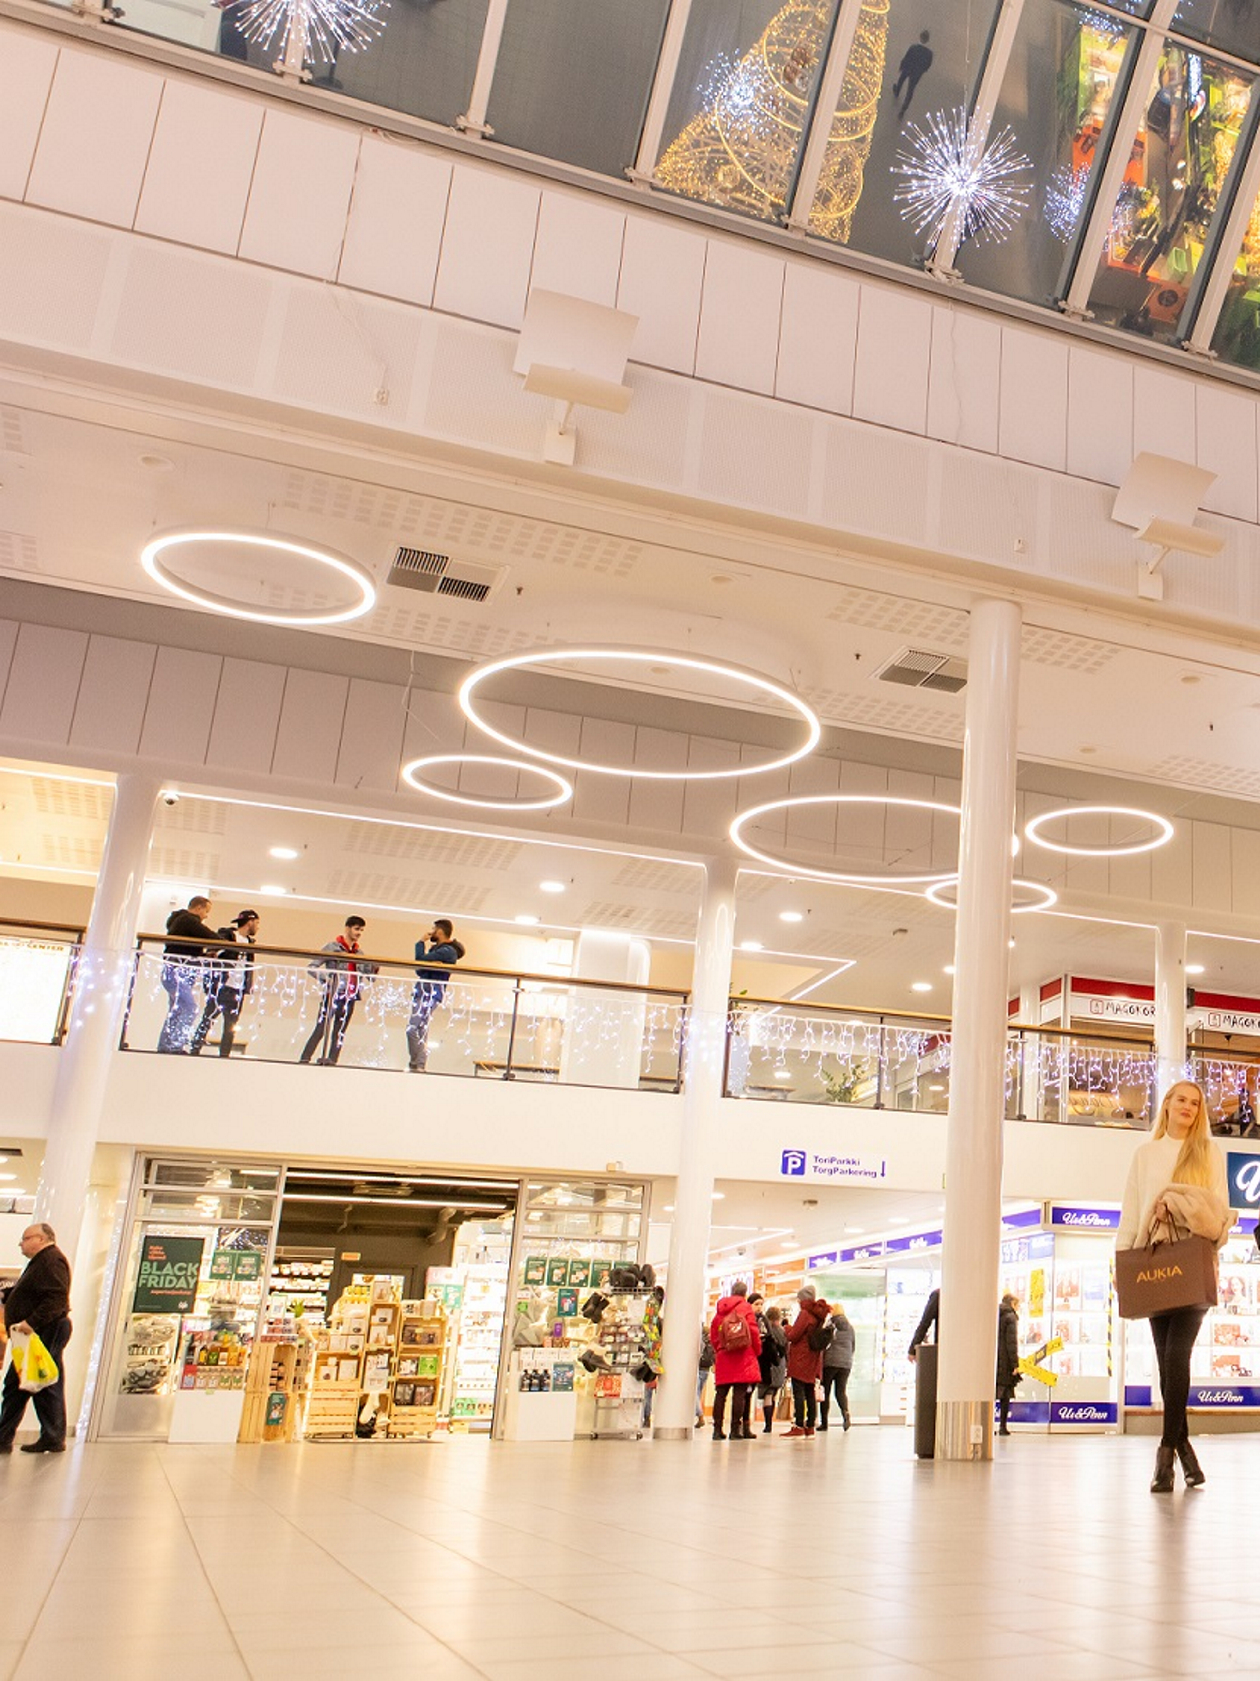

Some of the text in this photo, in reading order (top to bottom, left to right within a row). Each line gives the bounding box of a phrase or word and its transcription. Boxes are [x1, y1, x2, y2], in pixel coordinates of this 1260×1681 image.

[1105, 1000, 1156, 1016] MAGOKOR
[813, 1154, 861, 1167] ToriParkki
[812, 1165, 878, 1179] TorgParkering
[141, 1261, 199, 1276] BLACK
[1136, 1265, 1183, 1283] AUKIA
[138, 1275, 198, 1289] FRIDAY
